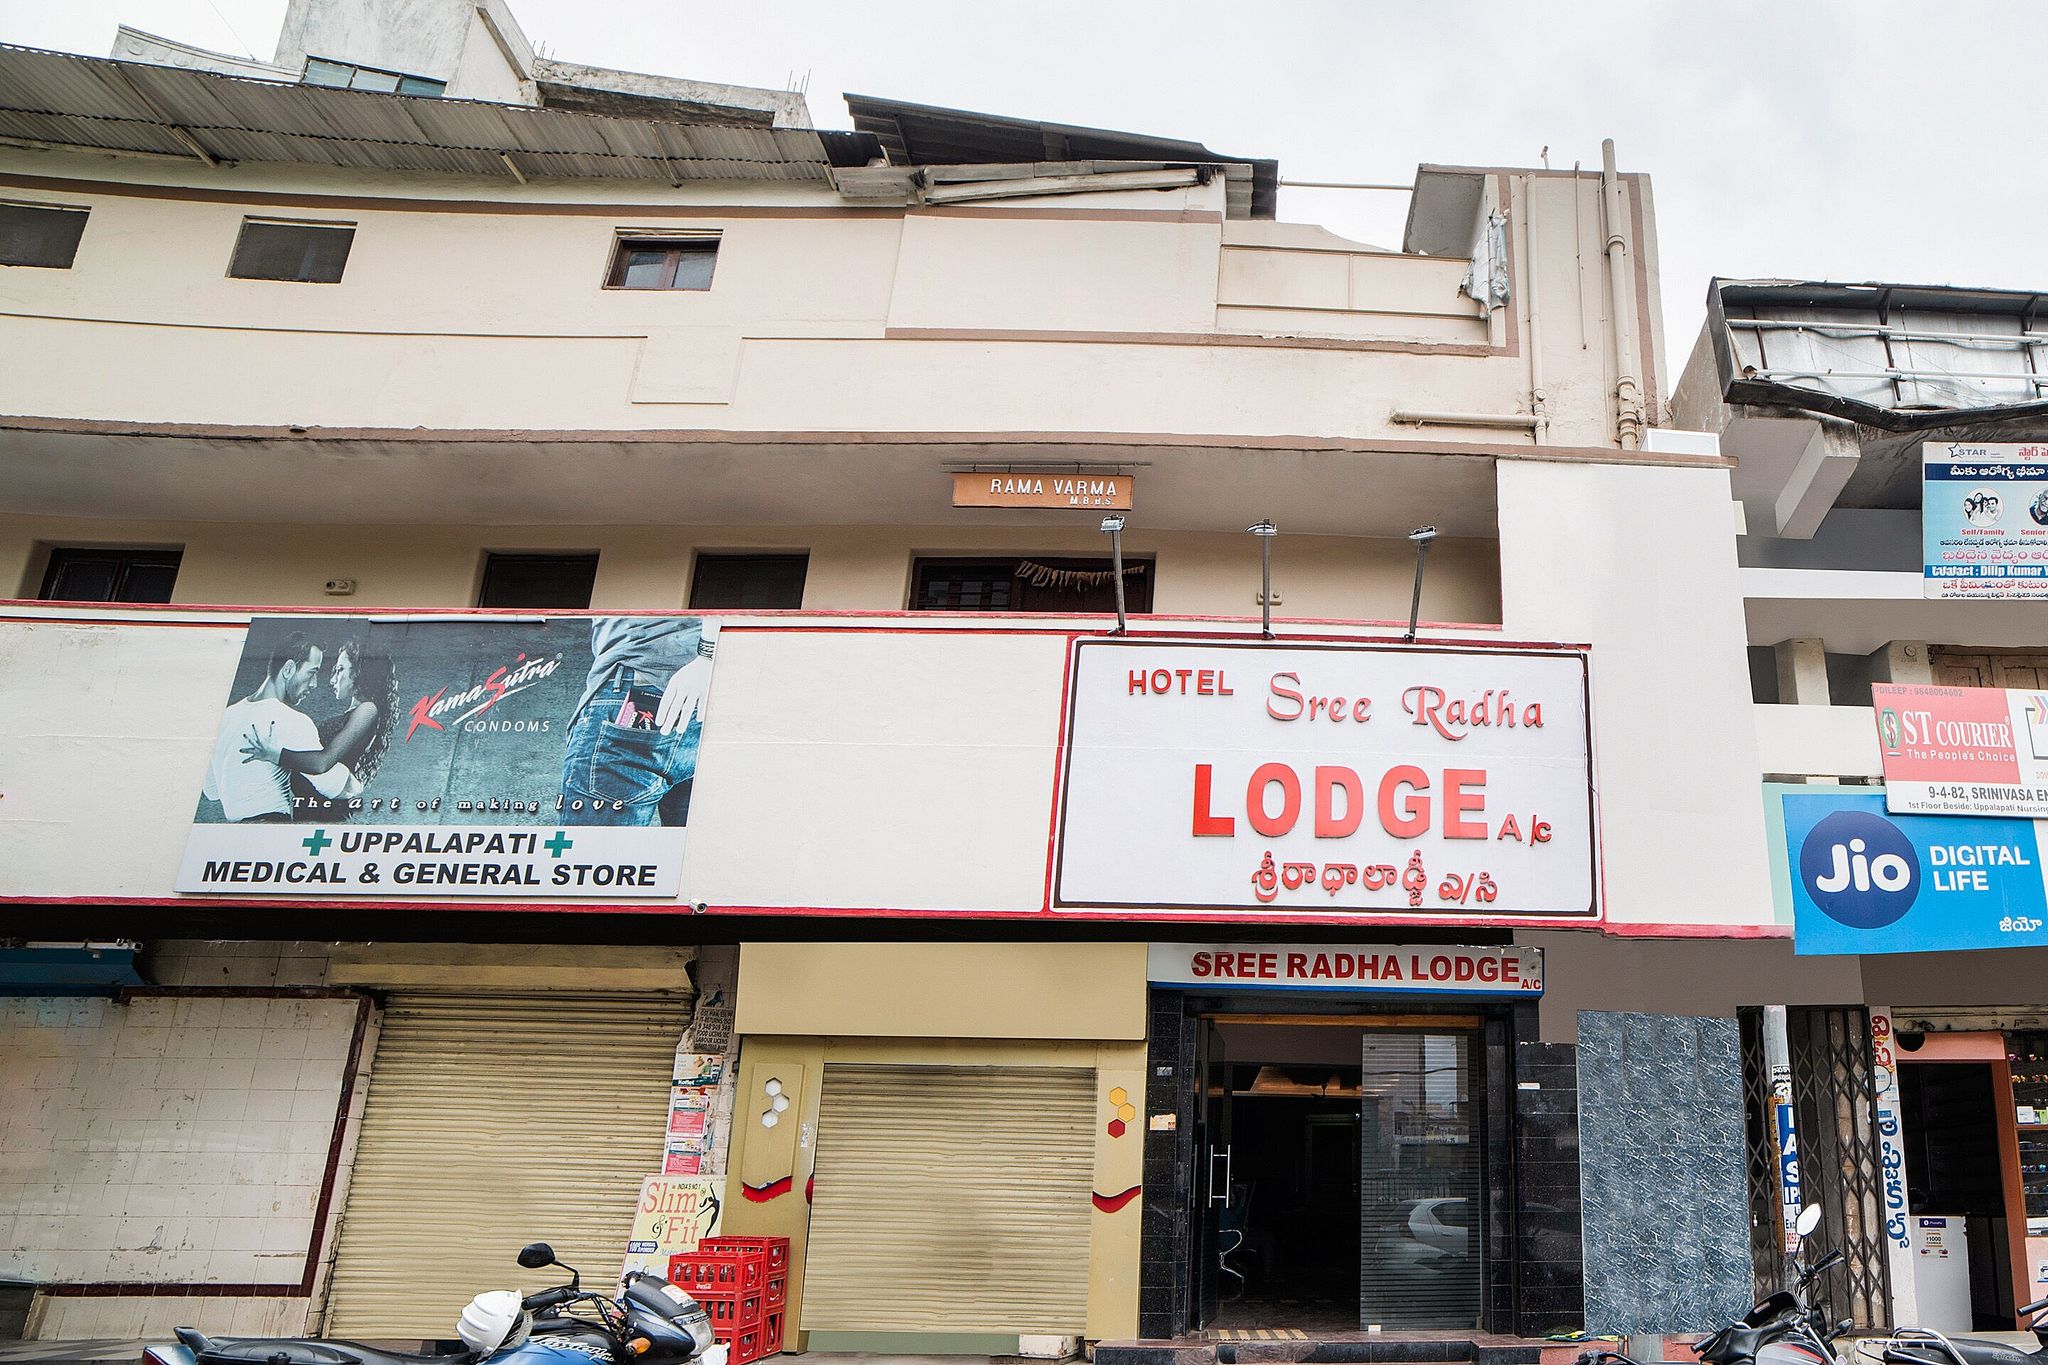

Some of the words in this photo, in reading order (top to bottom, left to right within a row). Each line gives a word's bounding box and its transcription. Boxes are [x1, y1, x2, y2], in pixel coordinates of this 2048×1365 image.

[1959, 448, 1987, 456] STAR
[990, 478, 1043, 495] RAMA
[1053, 479, 1117, 496] VARMA
[2007, 566, 2043, 576] Kumar
[1129, 668, 1234, 697] HOTEL
[1266, 671, 1372, 724] Sree
[1401, 684, 1545, 741] Radha
[464, 720, 550, 733] CONDOMS
[1902, 710, 1933, 746] ST
[1936, 721, 2013, 748] COURIER
[1907, 749, 1927, 760] The
[1931, 751, 1975, 762] People's
[1978, 751, 2016, 762] Choice
[292, 796, 332, 810] The
[348, 795, 400, 811] art
[417, 796, 438, 811] of
[457, 795, 540, 812] making
[554, 793, 626, 812] love
[1192, 762, 1488, 841] LODGE
[1929, 786, 1969, 801] 9-4-82,
[1972, 787, 2034, 802] SRINIVASA
[1921, 802, 1941, 810] Floor
[1974, 803, 2015, 813] Uppalapati
[339, 830, 537, 856] UPPALAPATI
[1816, 838, 1910, 893] Jio
[1929, 845, 2031, 866] DIGITAL
[201, 860, 346, 885] MEDICAL
[358, 860, 380, 885] &
[393, 861, 541, 886] GENERAL
[551, 862, 657, 887] STORE
[1933, 869, 1989, 892] LIFE
[1999, 916, 2043, 933] జియో
[1191, 952, 1277, 979] SREE
[1286, 953, 1403, 981] RADHA
[1411, 954, 1520, 983] LODGE
[1521, 978, 1542, 990] A/C
[641, 1182, 698, 1213] Slim
[651, 1214, 667, 1240] &
[663, 1216, 699, 1244] Fit
